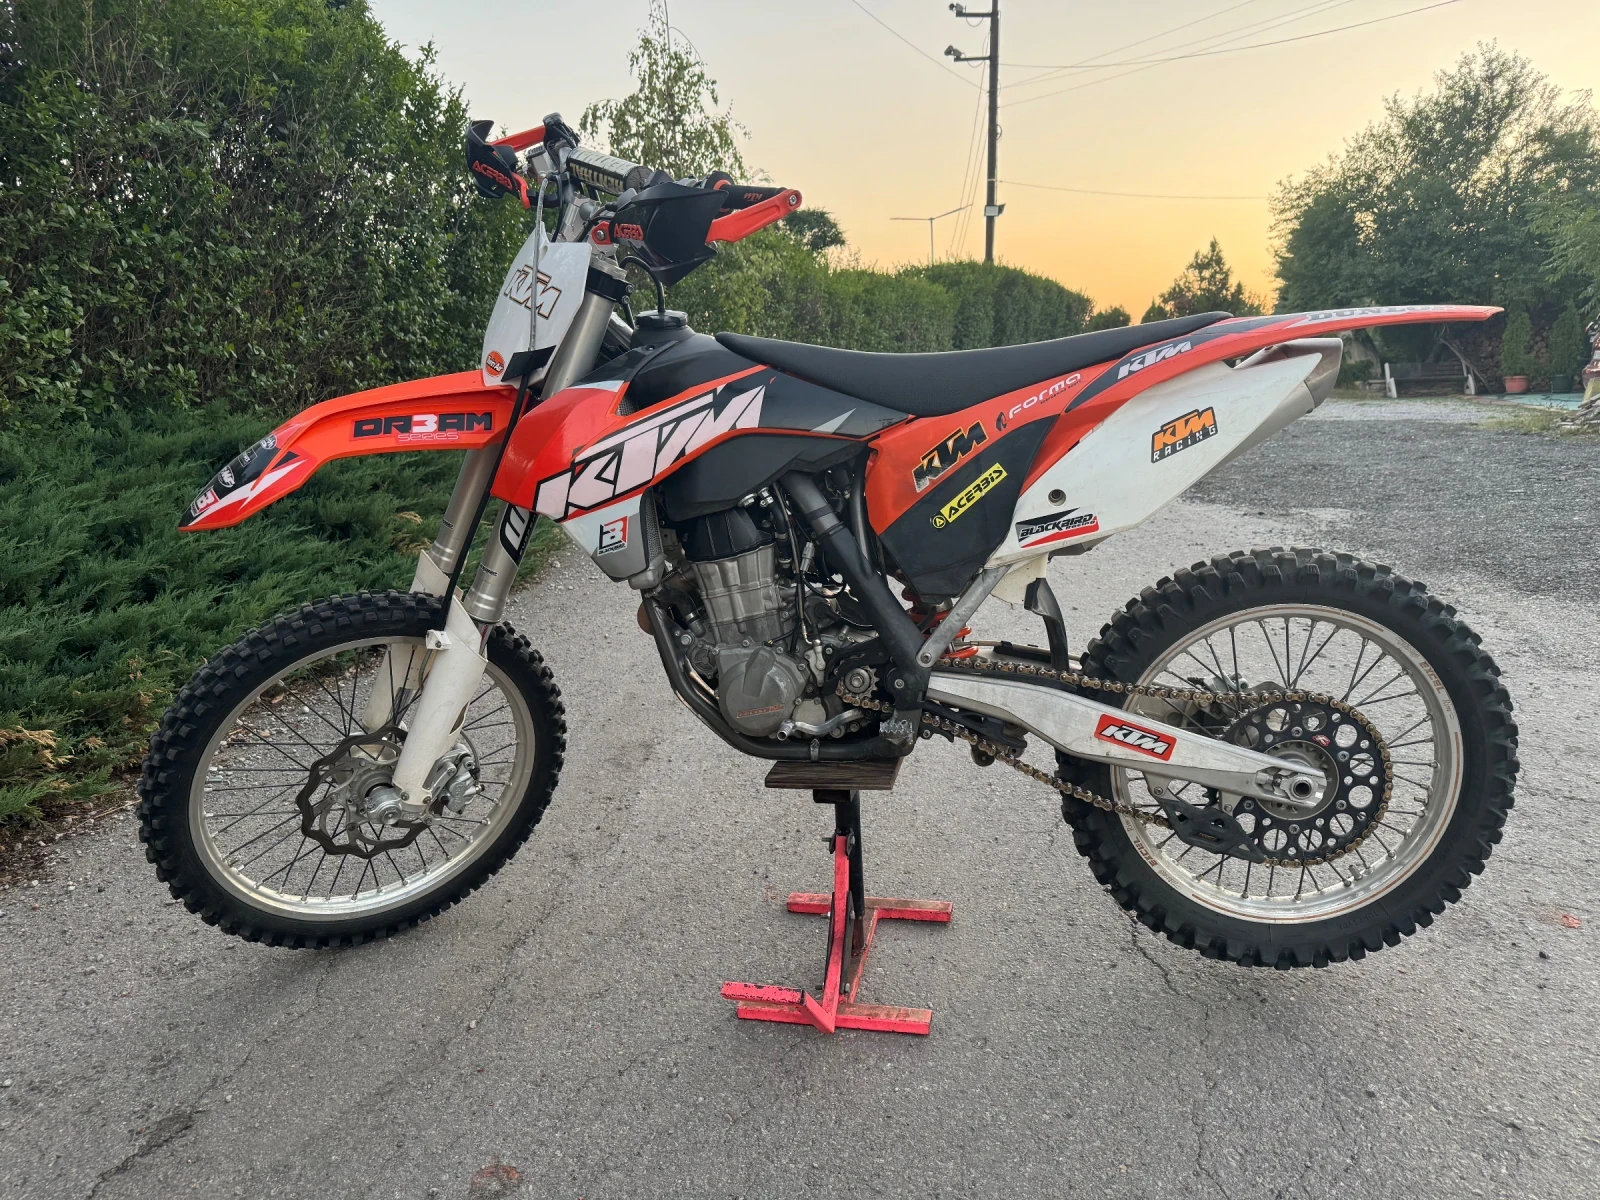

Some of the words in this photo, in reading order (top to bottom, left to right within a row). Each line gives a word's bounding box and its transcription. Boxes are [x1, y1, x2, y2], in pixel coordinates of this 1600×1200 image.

[504, 264, 562, 320] KTM
[1117, 340, 1192, 380] KTM
[535, 385, 766, 522] KTM
[1153, 408, 1215, 452] KTM
[912, 420, 989, 493] KTM
[1099, 723, 1171, 755] KTM
